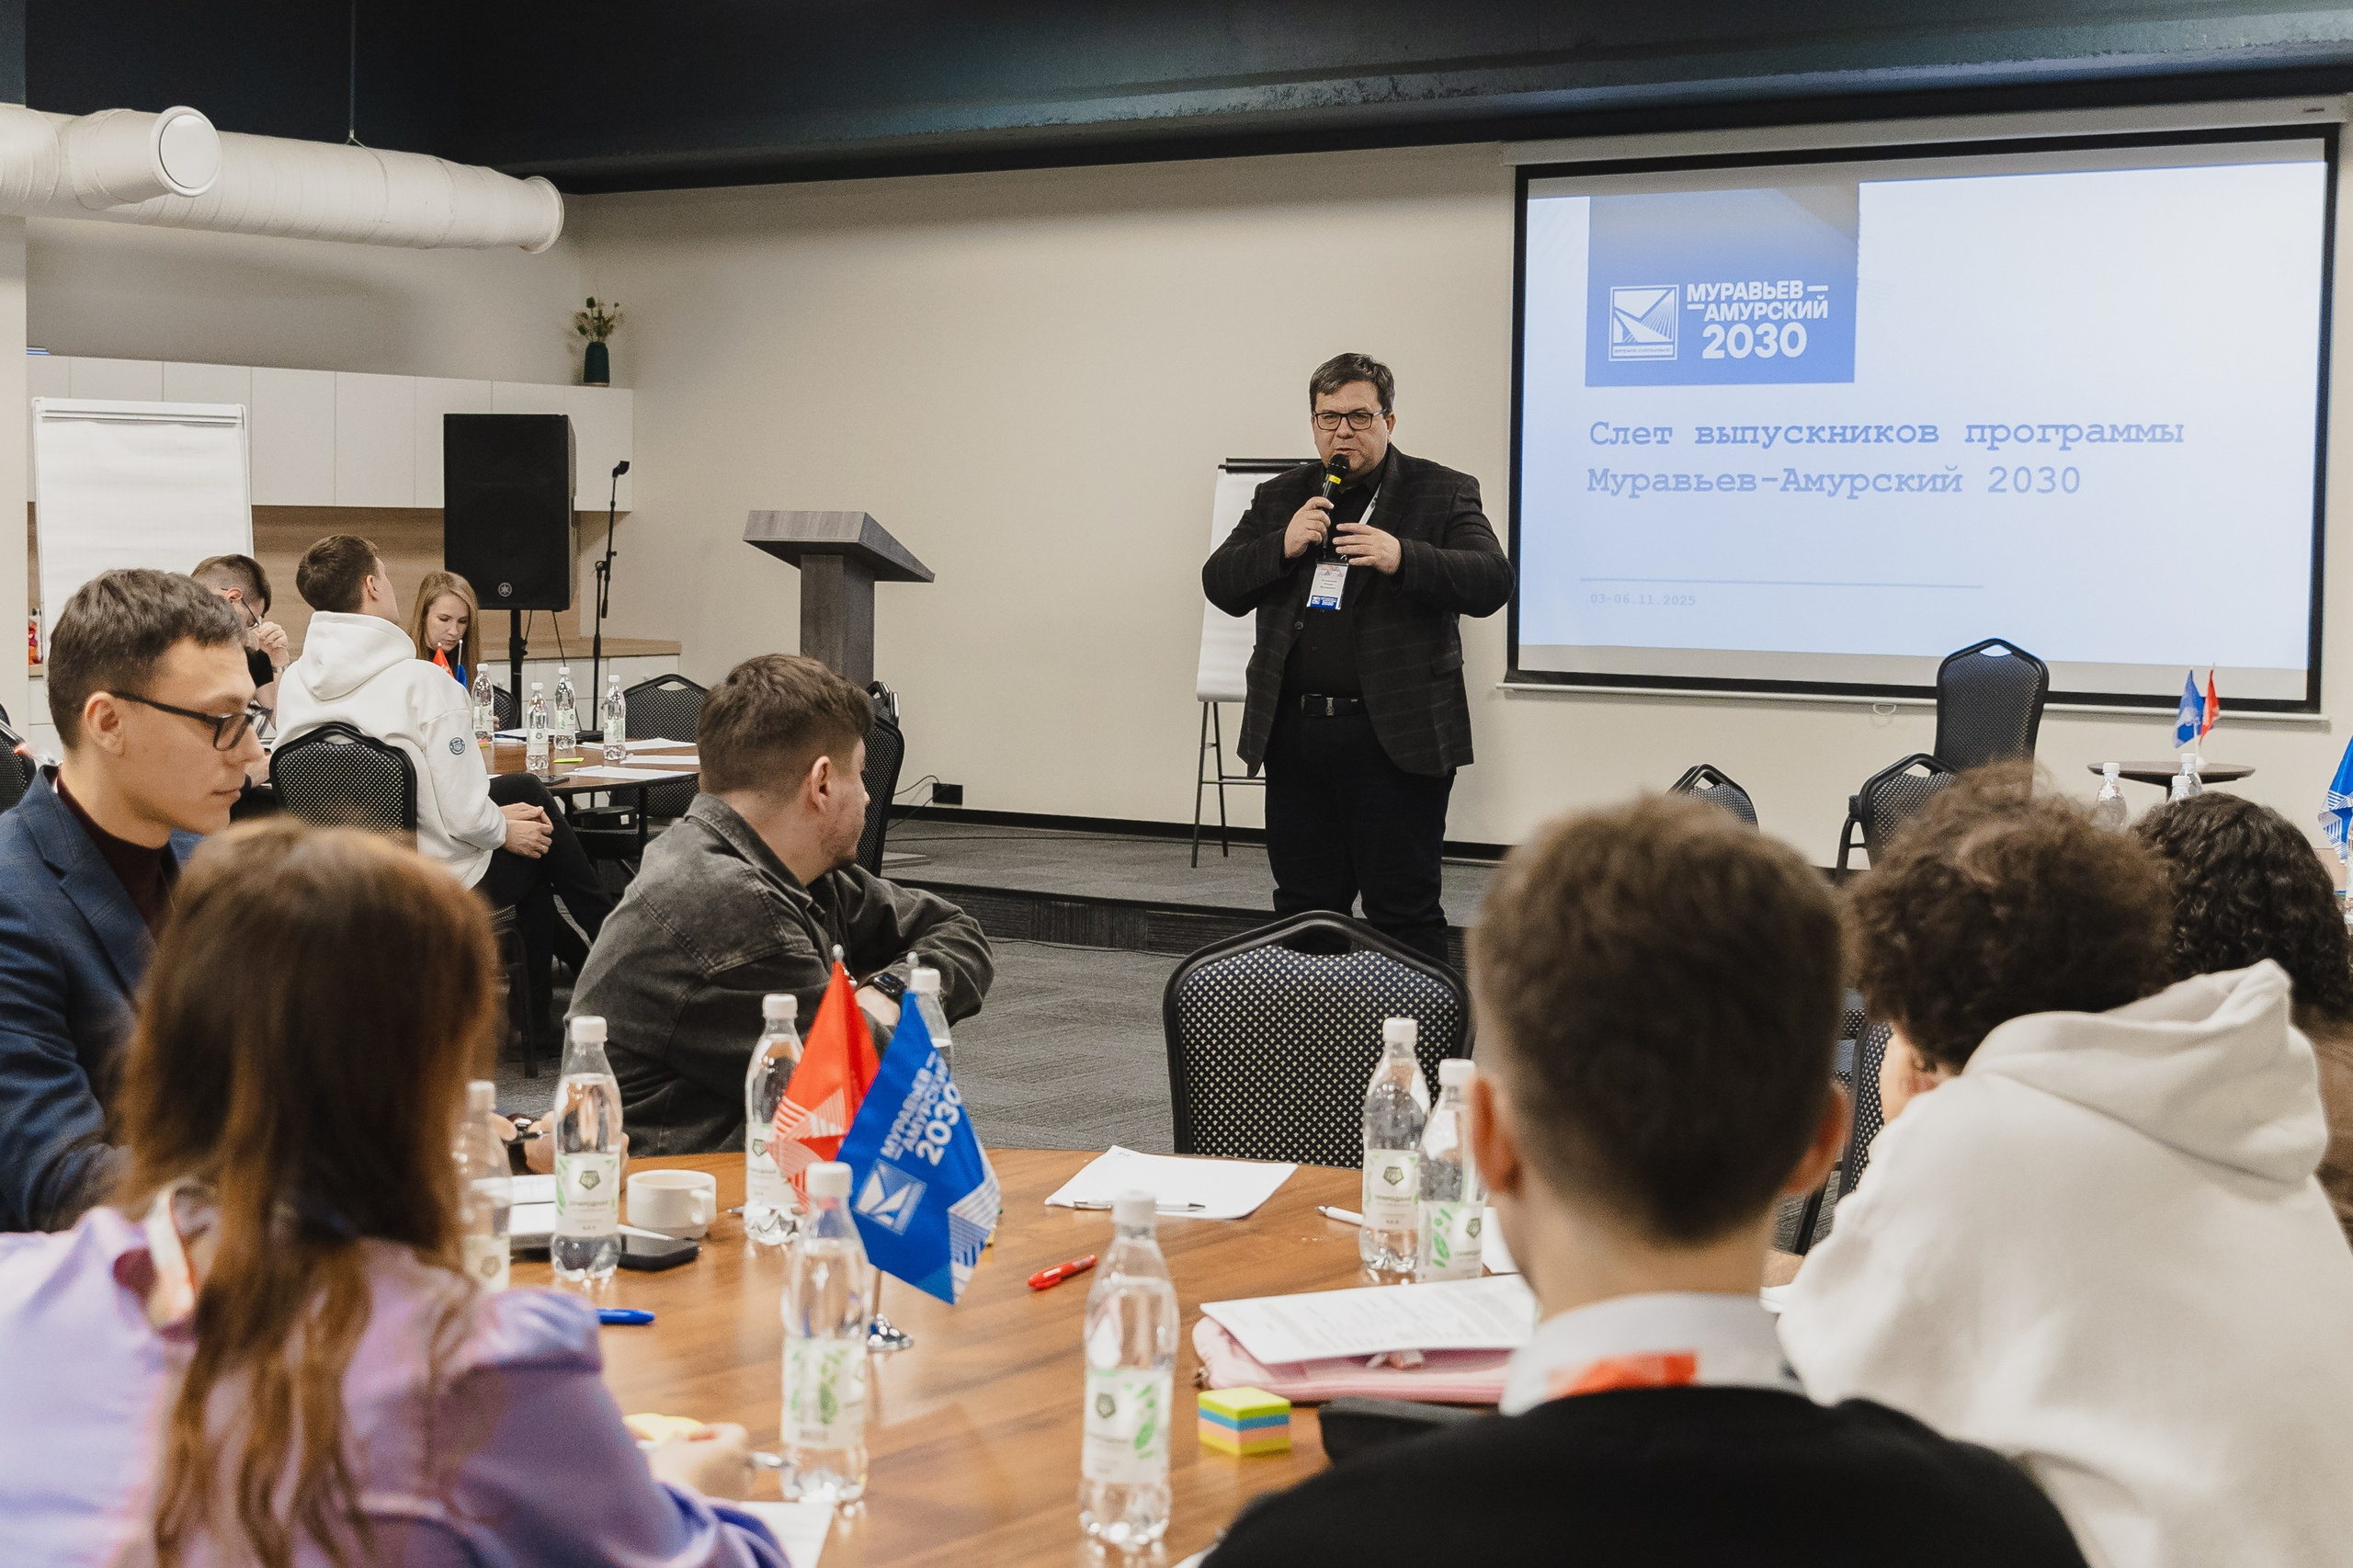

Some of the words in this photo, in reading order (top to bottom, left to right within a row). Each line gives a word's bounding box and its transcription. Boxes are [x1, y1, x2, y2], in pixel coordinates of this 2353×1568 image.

[1702, 322, 1807, 359] 2030
[1589, 421, 1673, 445] Слет
[1695, 422, 1939, 449] выпускников
[1965, 422, 2185, 450] программы
[1587, 464, 1963, 498] Муравьев-Амурский
[1987, 466, 2081, 494] 2030
[915, 1081, 962, 1166] 2030
